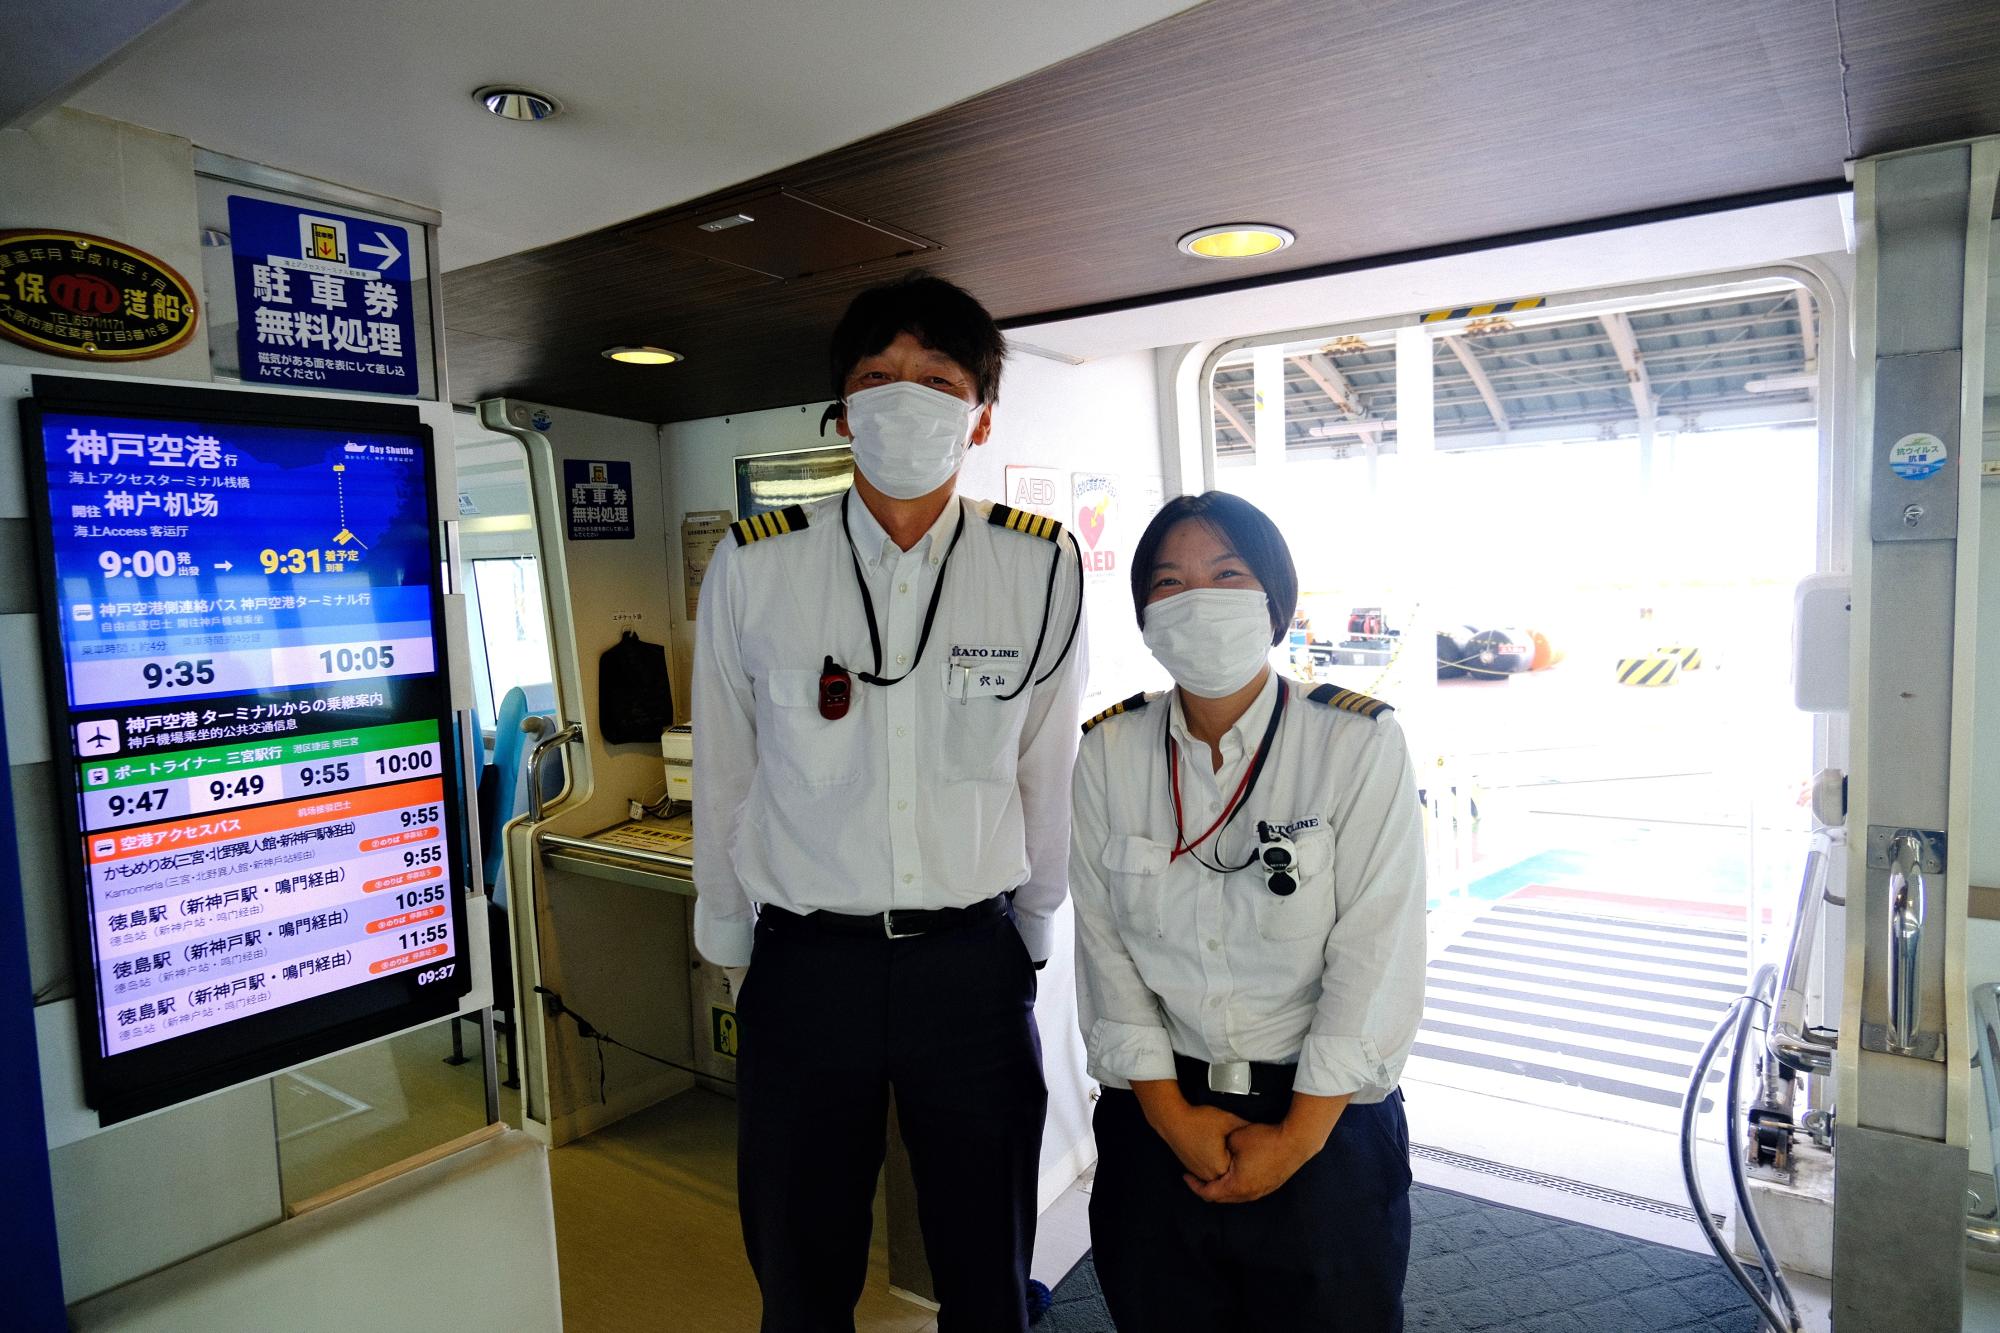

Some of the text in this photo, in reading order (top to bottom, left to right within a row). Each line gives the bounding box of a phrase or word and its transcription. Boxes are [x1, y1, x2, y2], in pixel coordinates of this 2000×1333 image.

[253, 264, 399, 318] 駐車券
[123, 288, 180, 322] 造船
[254, 306, 403, 357] 無料処理
[258, 351, 405, 377] 磁気がある面を表にして差し込
[259, 365, 326, 381] んでください
[572, 488, 627, 505] 駐車券
[1015, 477, 1056, 506] AED
[573, 507, 629, 524] 無料処理
[98, 550, 176, 578] 9:00
[259, 549, 360, 574] 9:31 着予定
[1082, 550, 1116, 573] AED
[319, 645, 395, 674] 10:05
[991, 649, 1019, 658] LINE
[143, 659, 214, 689] 9:35
[979, 675, 1005, 687] 穴山
[126, 691, 384, 735] 神戸空港 ターミナルからの乗継案内
[114, 745, 283, 781] ポートライナー 三宮駅行
[300, 762, 350, 787] 9:55
[376, 750, 433, 775] 10:00
[209, 775, 264, 801] 9:49
[109, 788, 169, 817] 9:47
[400, 806, 439, 828] 9:55
[121, 818, 242, 851] 空港アクセスバス
[403, 845, 442, 867] 9:55
[396, 885, 445, 910] 10:55
[399, 923, 448, 950] 11:55
[418, 963, 455, 987] 09:37
